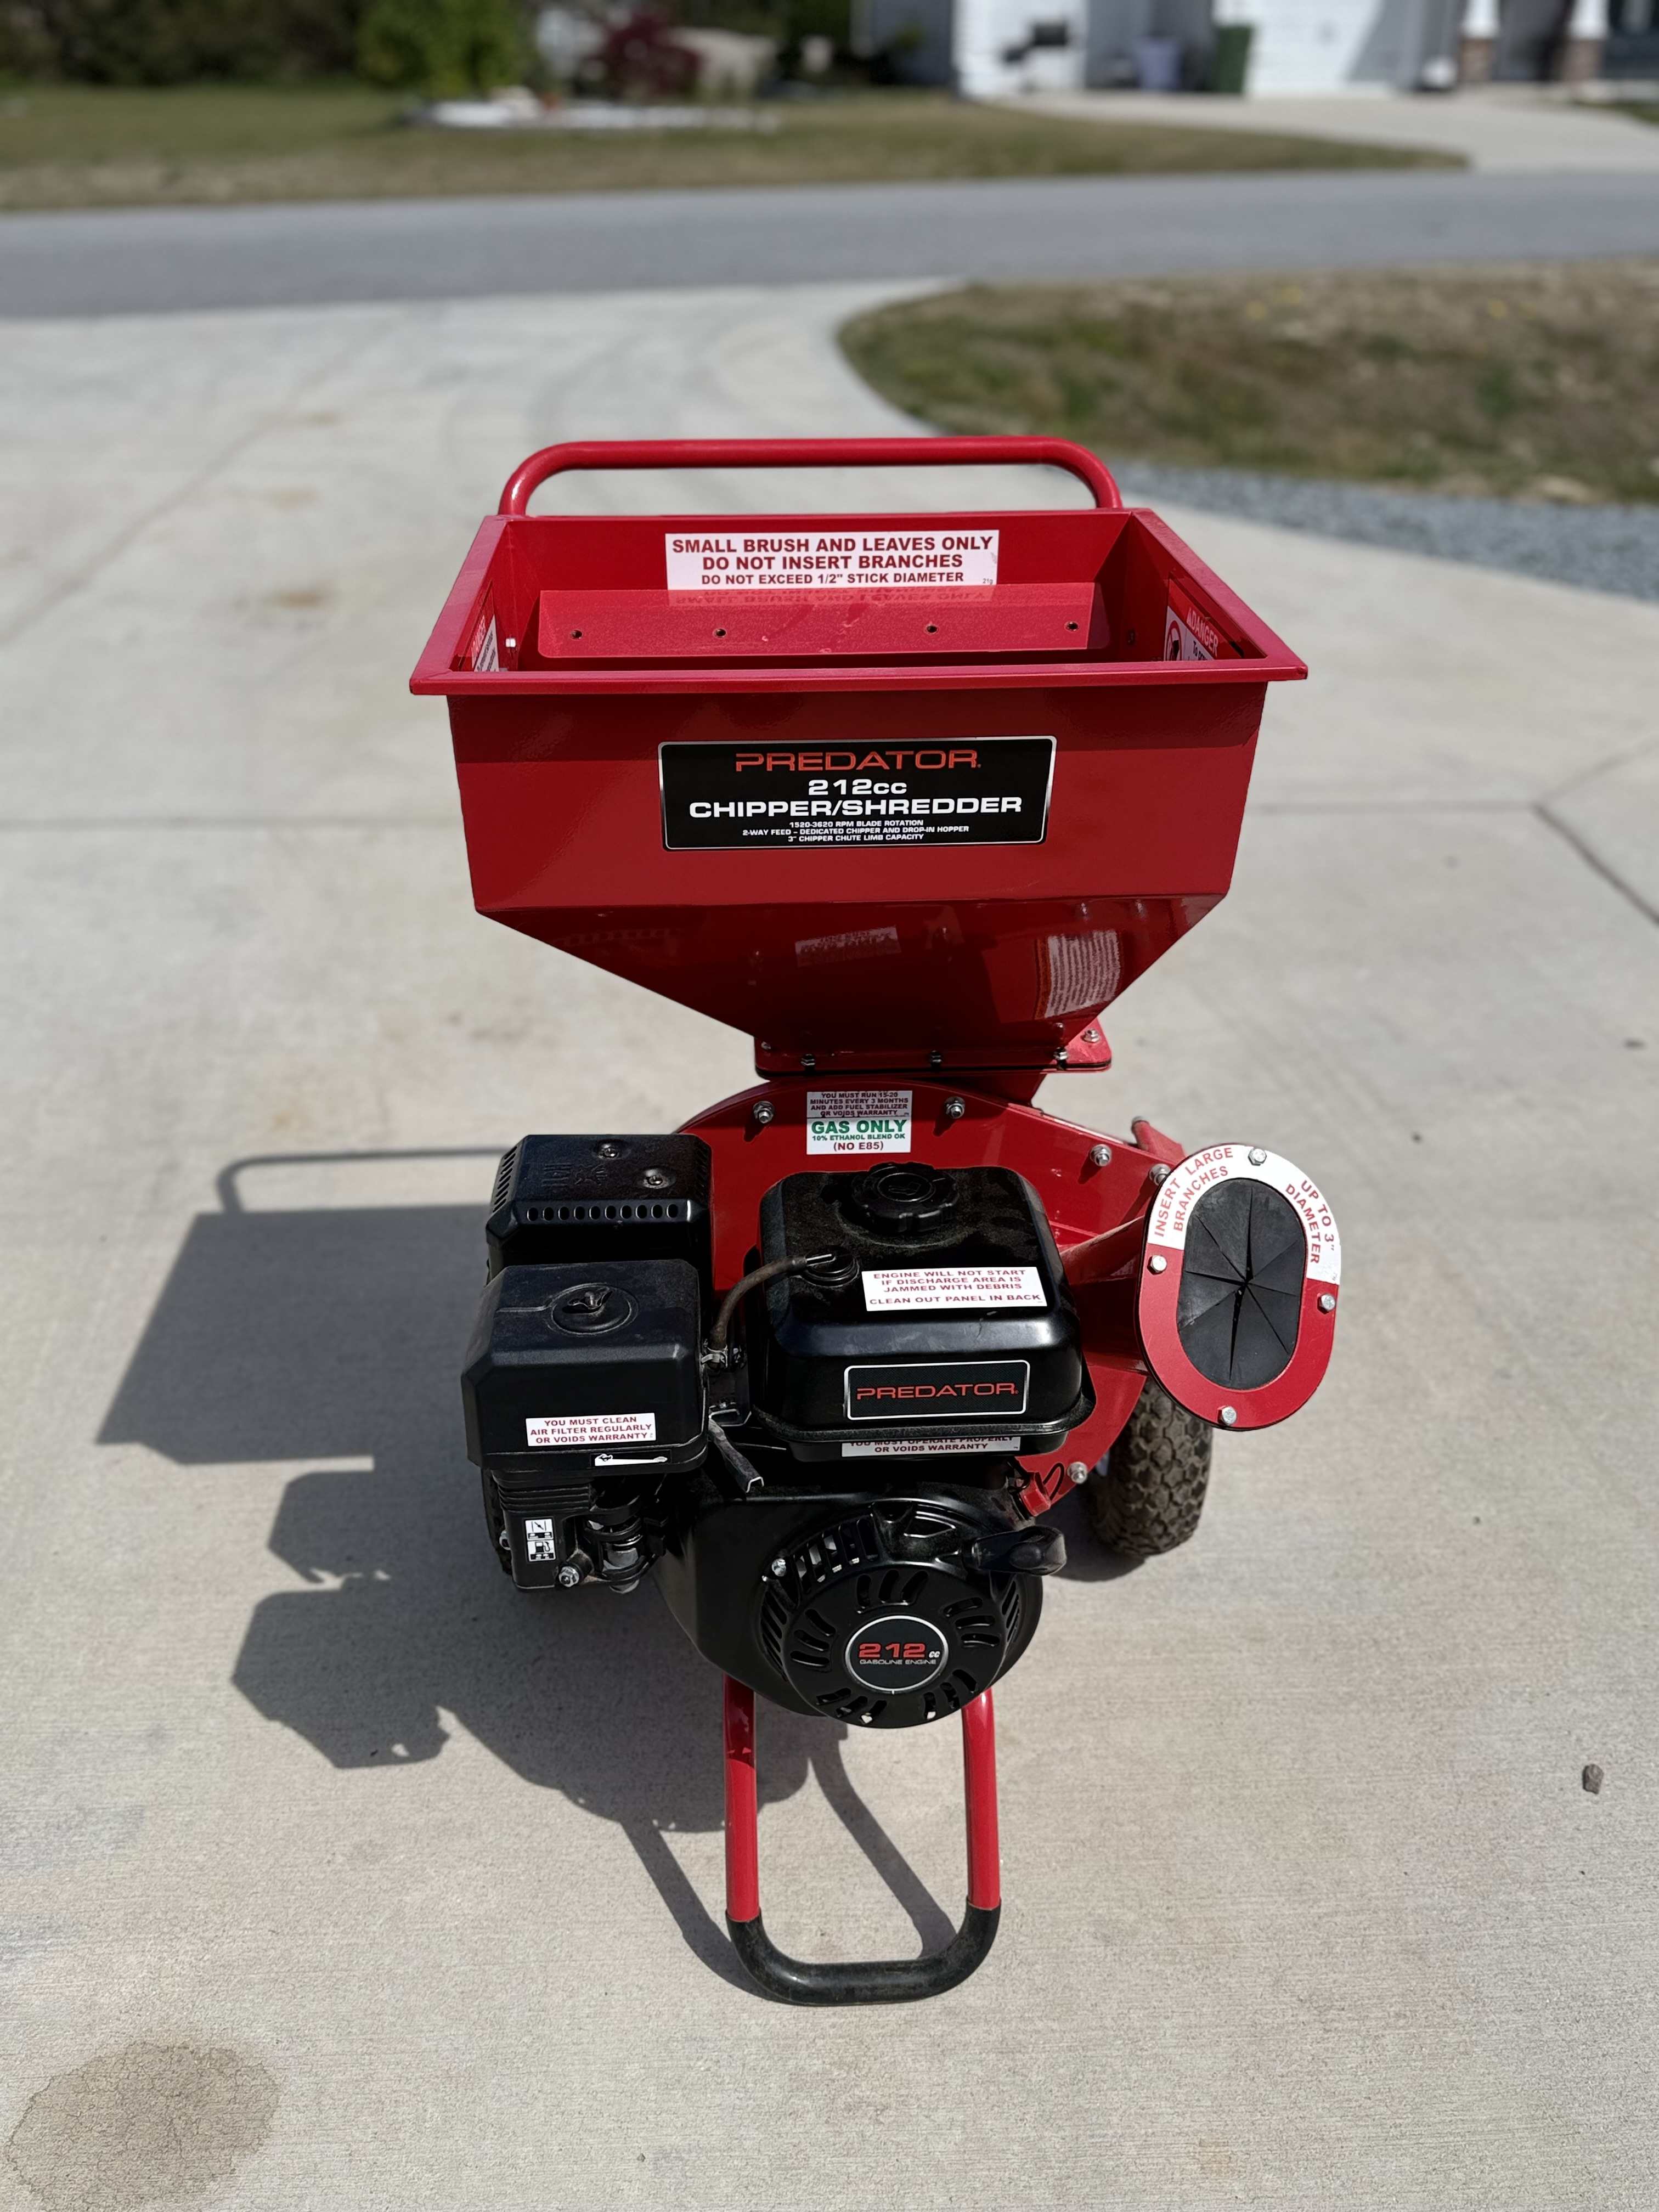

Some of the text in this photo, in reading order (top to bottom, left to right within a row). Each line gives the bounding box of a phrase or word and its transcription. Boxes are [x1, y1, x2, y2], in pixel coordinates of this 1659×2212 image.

[673, 536, 994, 553] SMALL BRUSH AND LEAVES ONLY
[703, 555, 963, 571] DO NOT INSERT BRANCHES
[702, 572, 964, 585] DO NOT EXCEED 1/2" STICK DIAMETER
[1192, 610, 1218, 658] DANGER
[736, 750, 977, 772] PREDATOR
[808, 779, 907, 795] 212cc
[689, 797, 1022, 818] CHIPPER/SHREDDER
[811, 1120, 907, 1134] GAS ONLY
[833, 1141, 884, 1152] (NO E85)
[1154, 1148, 1233, 1237] INSERT LARGE
[1173, 1166, 1228, 1232] BRANCHES
[1301, 1180, 1319, 1200] UP
[1318, 1204, 1331, 1227] TO
[1285, 1183, 1321, 1263] DIAMETER
[856, 1383, 1014, 1400] PREDATOR
[590, 1424, 652, 1432] REGULARLY
[589, 1433, 648, 1441] WARRANTY
[859, 1643, 926, 1658] 212
